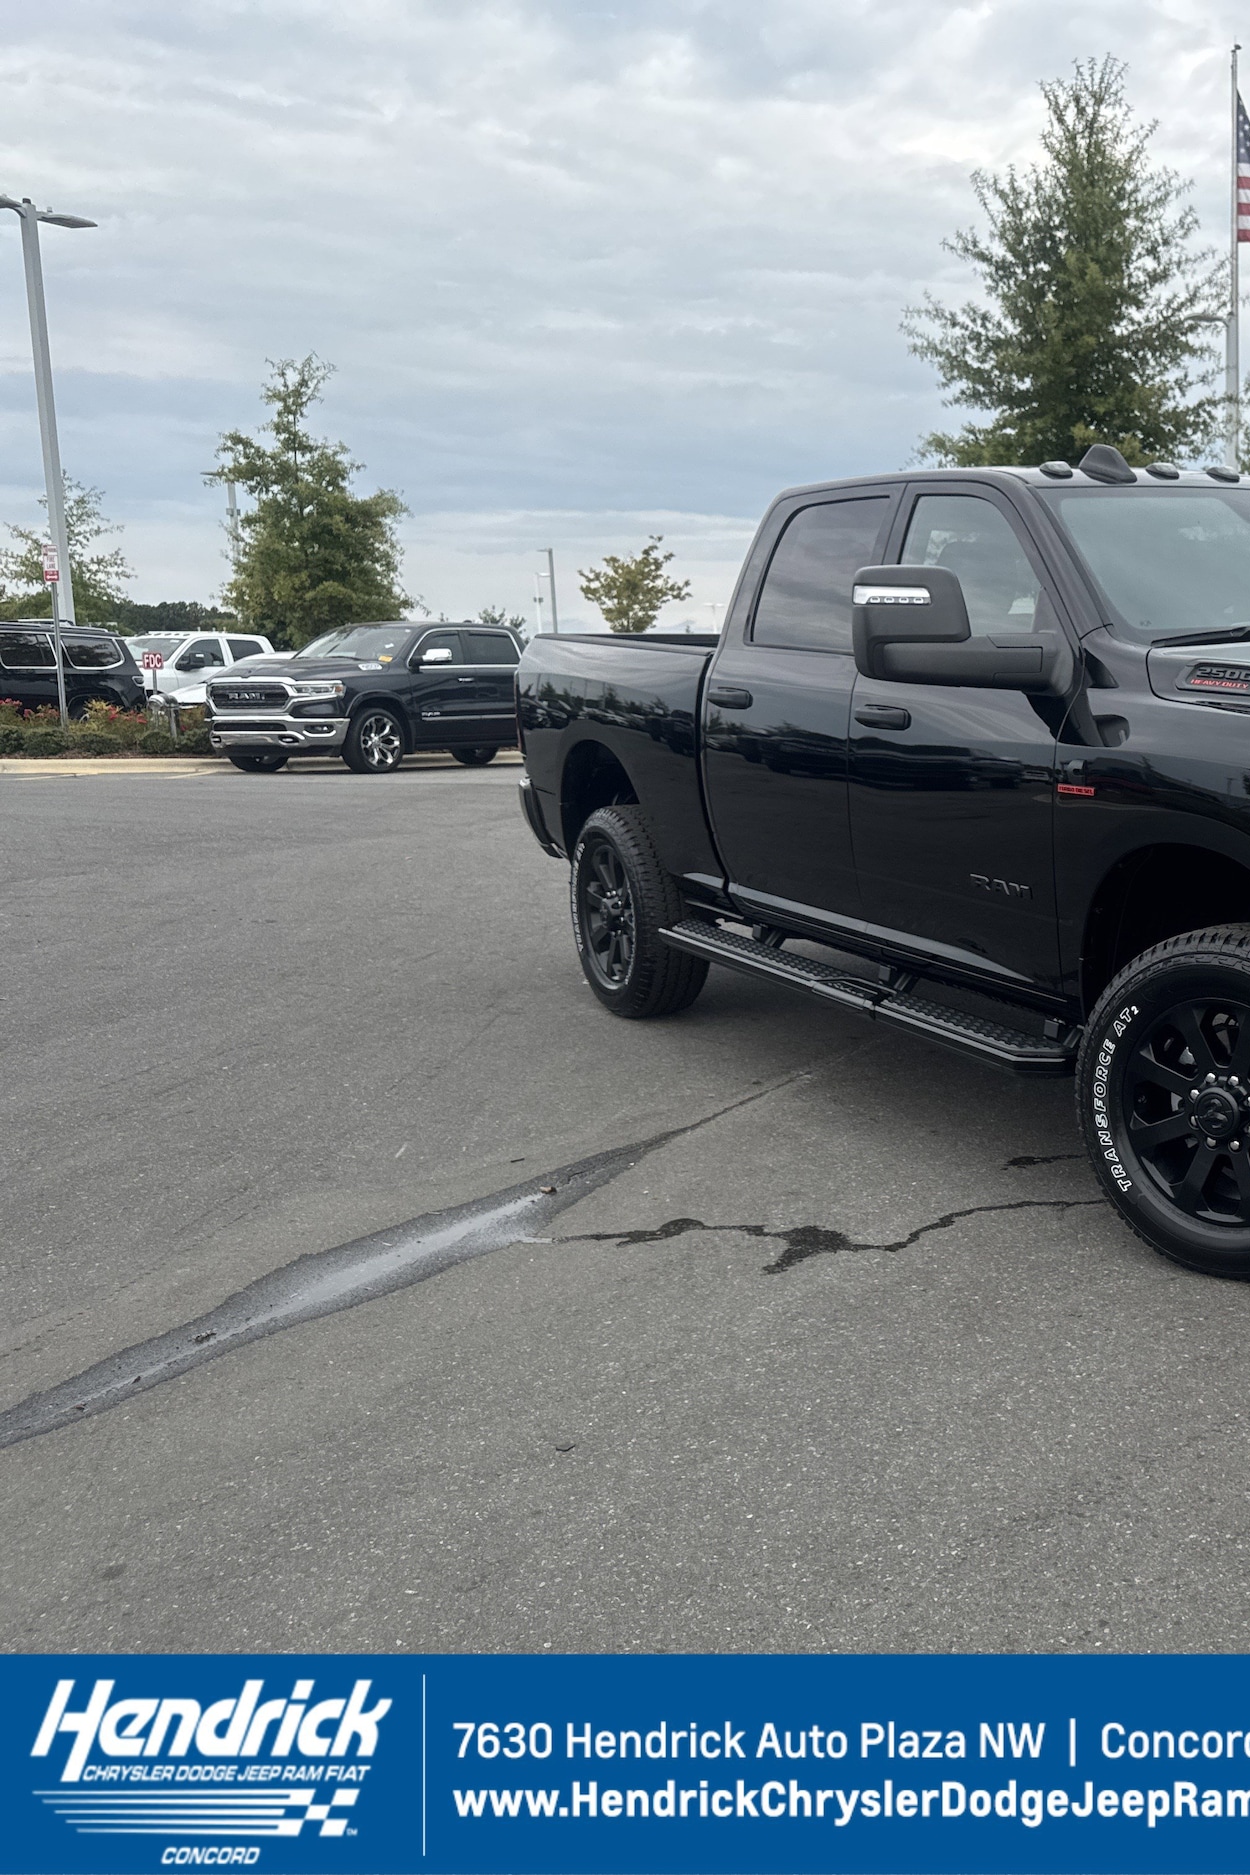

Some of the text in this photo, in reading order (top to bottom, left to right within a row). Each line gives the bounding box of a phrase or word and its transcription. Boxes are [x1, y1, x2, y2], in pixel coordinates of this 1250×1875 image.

[144, 654, 162, 668] FDC
[1190, 678, 1249, 690] HEAVY DUTY
[970, 873, 1033, 900] RAM
[1093, 1038, 1132, 1192] TRANSFORCE
